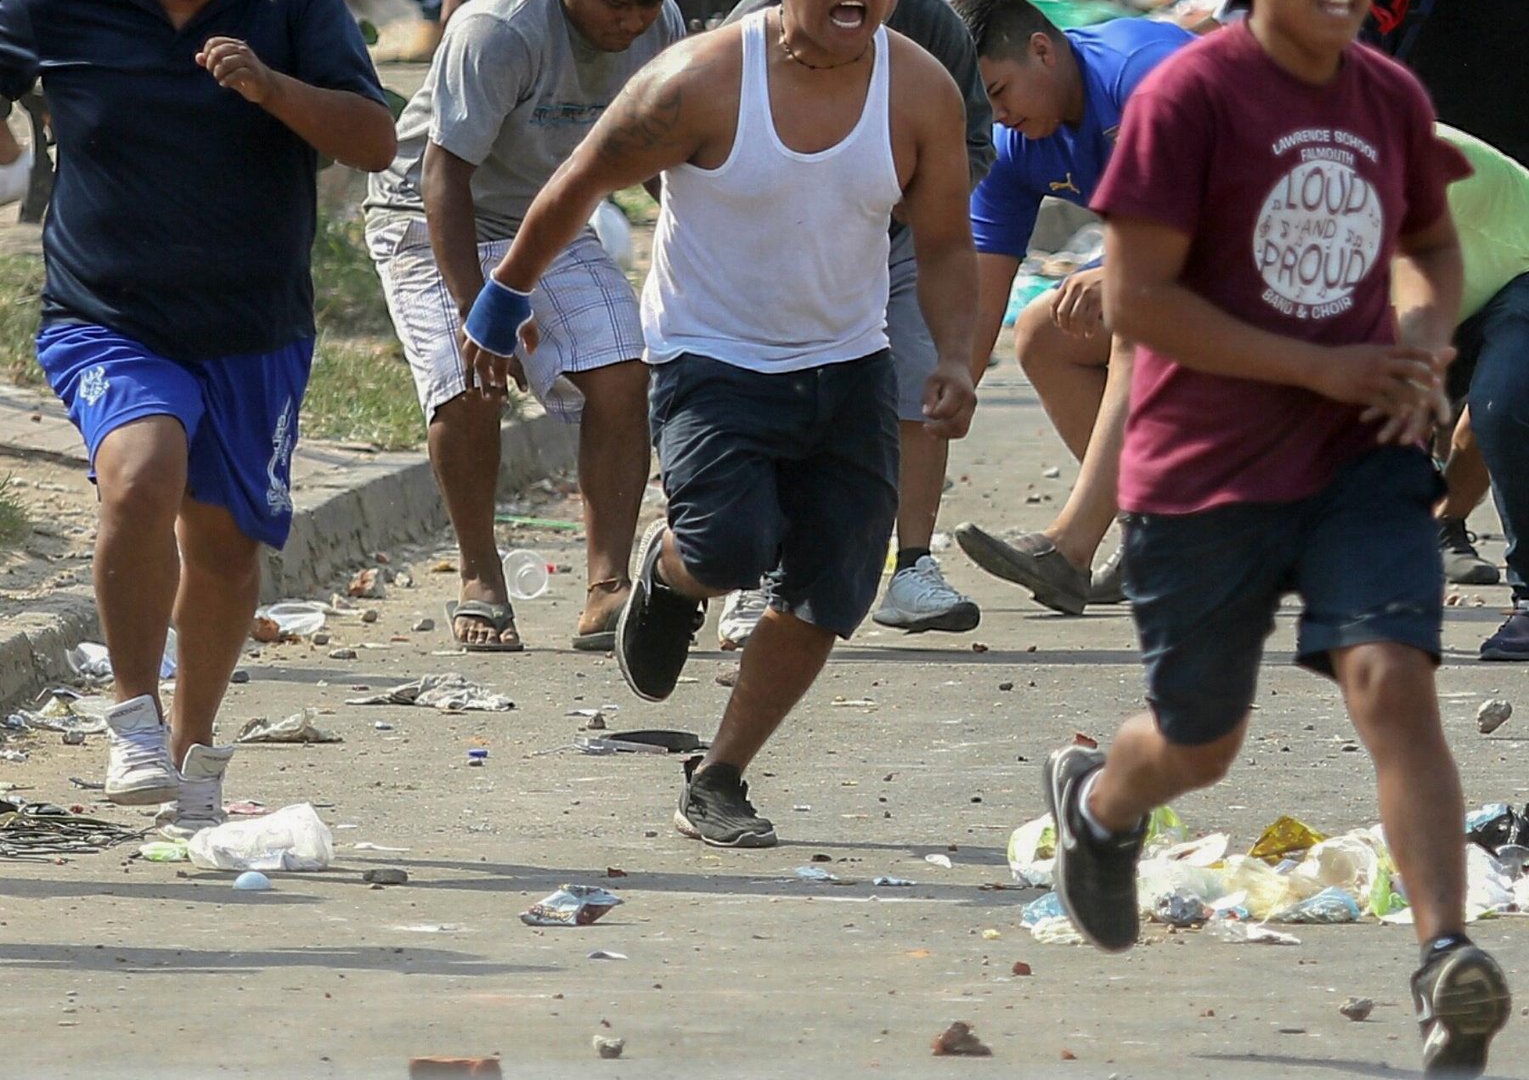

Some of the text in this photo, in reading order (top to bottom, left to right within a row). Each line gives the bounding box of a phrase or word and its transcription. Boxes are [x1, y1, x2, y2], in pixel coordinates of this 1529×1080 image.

[1272, 128, 1378, 163] LAWRENCE SCHOOL
[1300, 146, 1354, 166] FALMOUTH
[1285, 166, 1369, 216] LOUD
[1300, 218, 1337, 240] AND
[1261, 239, 1366, 290] PROUD
[1262, 287, 1353, 320] BAND & CHOIR
